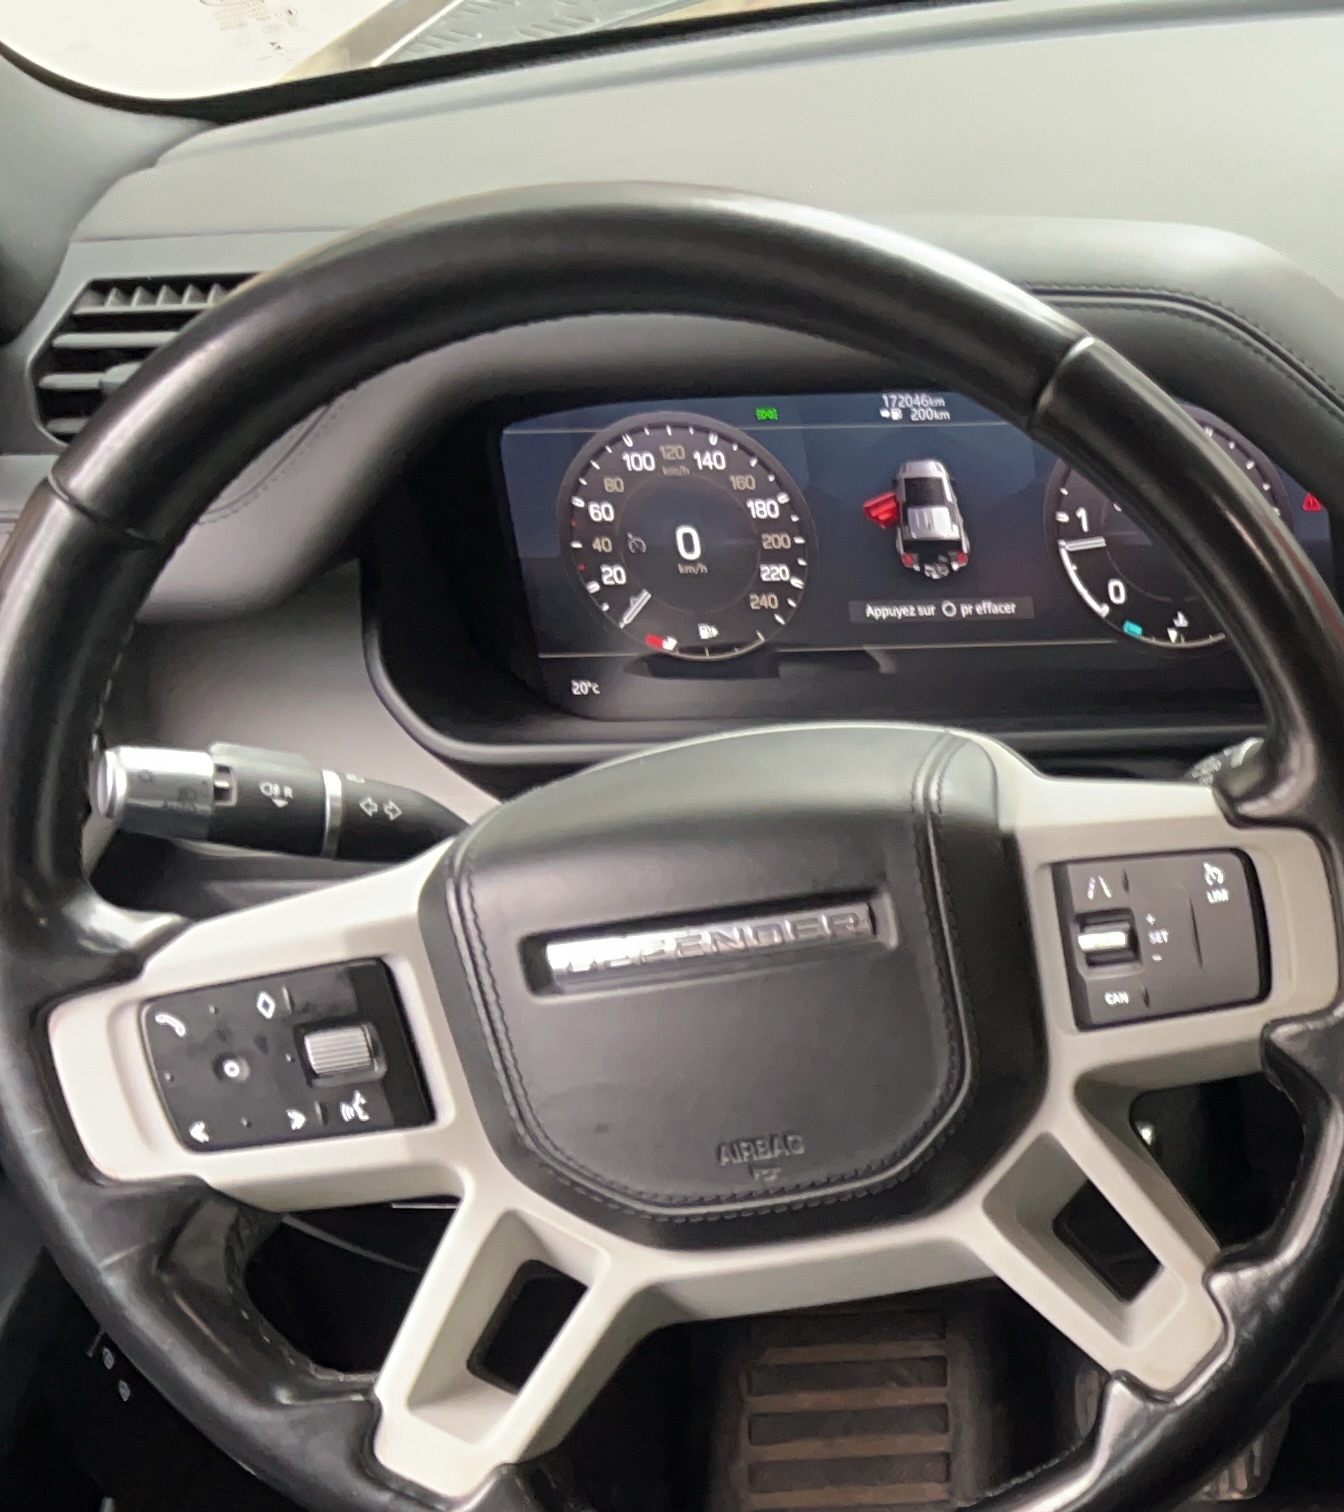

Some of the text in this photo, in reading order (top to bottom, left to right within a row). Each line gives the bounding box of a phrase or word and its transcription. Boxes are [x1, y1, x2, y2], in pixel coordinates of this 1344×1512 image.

[910, 408, 951, 421] 200km
[622, 452, 656, 471] 100
[660, 445, 685, 460] 120
[693, 450, 726, 471] 140
[603, 477, 624, 493] 80
[729, 475, 756, 491] 160
[588, 501, 615, 522] 60
[746, 498, 780, 519] 180
[1075, 506, 1090, 533] 1
[591, 536, 612, 553] 40
[675, 525, 702, 561] 0
[761, 534, 791, 549] 200
[600, 565, 627, 586] 20
[678, 562, 708, 575] km/h
[759, 563, 790, 582] 220
[1108, 578, 1127, 605] 0
[749, 593, 779, 610] 240
[960, 599, 1016, 619] pr effacer
[866, 602, 937, 620] Appuyez sur
[1207, 889, 1229, 904] LIM
[1149, 929, 1169, 944] SET
[1104, 991, 1129, 1006] CAN
[717, 1134, 805, 1166] AIRBAG
